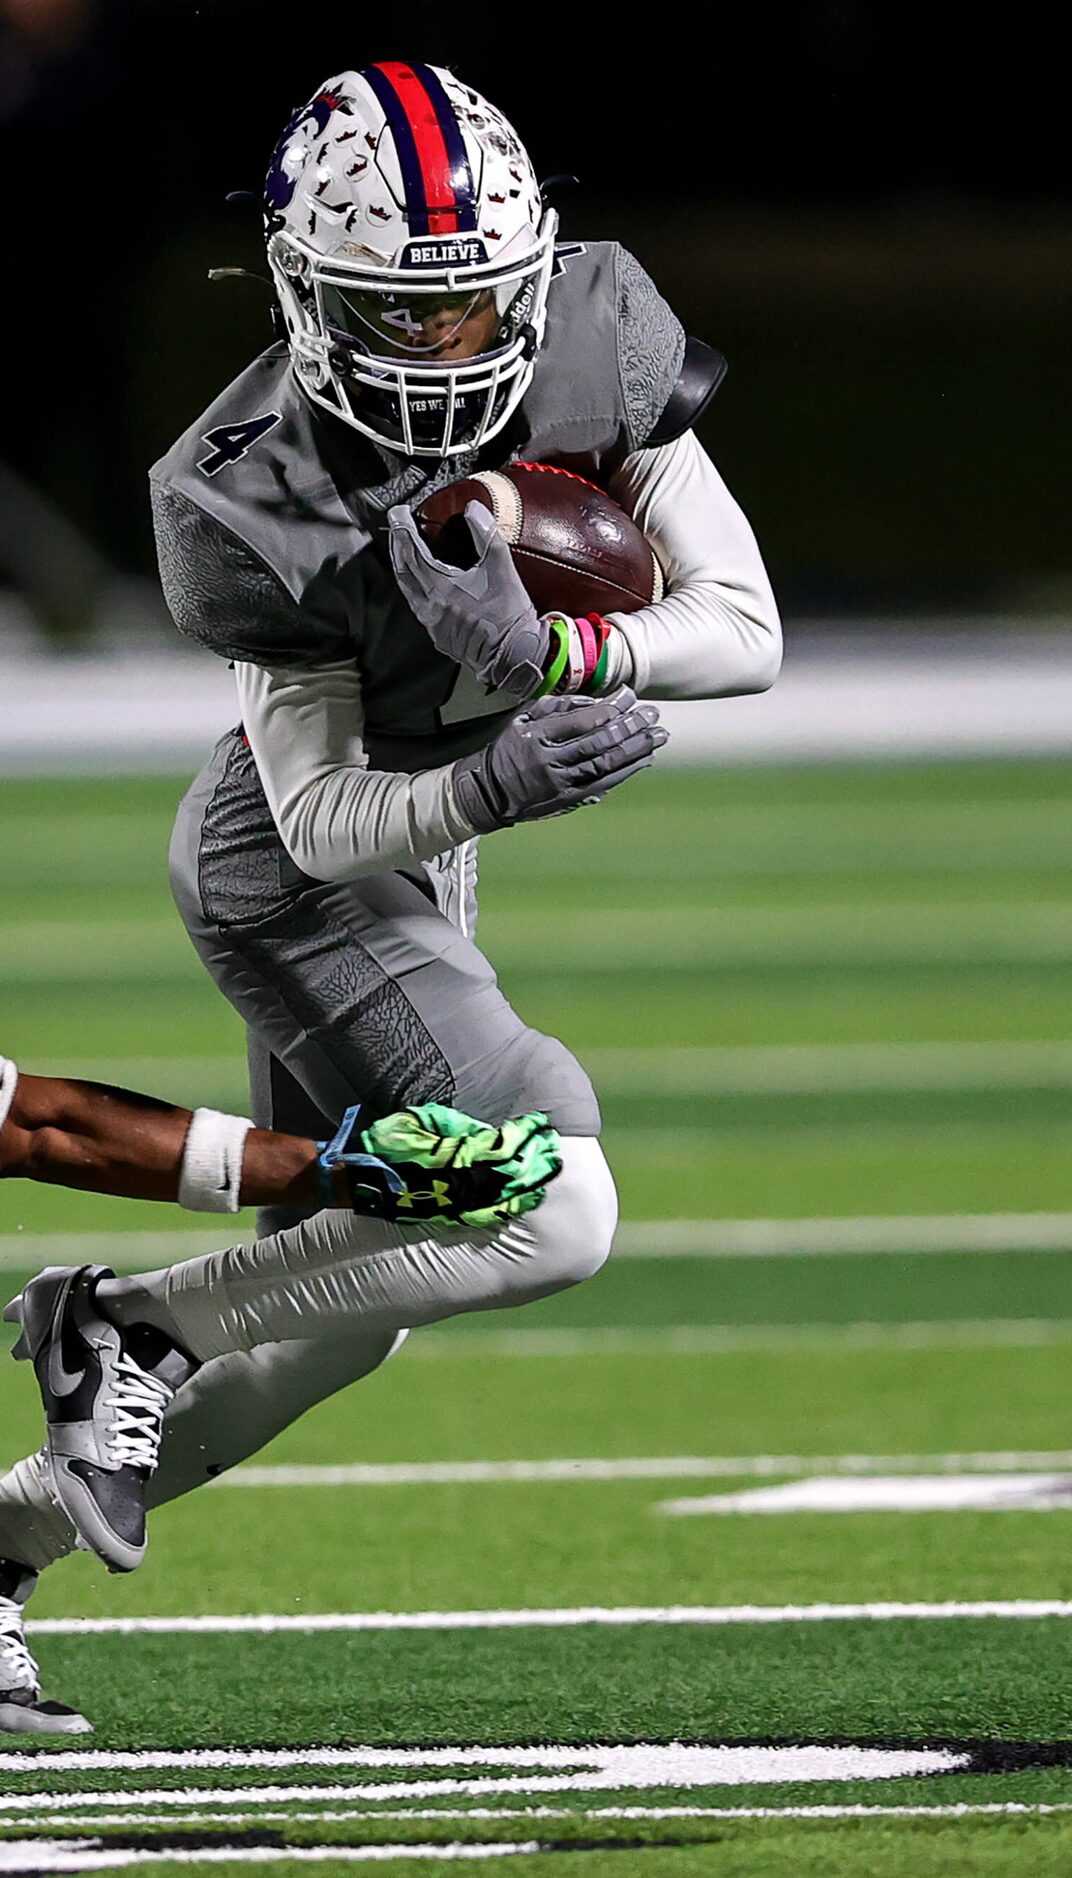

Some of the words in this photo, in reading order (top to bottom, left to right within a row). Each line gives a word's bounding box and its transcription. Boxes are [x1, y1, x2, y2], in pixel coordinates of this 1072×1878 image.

[410, 243, 480, 263] BELIEVE
[499, 282, 535, 339] Rddell
[409, 401, 427, 412] YES
[428, 399, 445, 411] WE
[196, 410, 284, 477] 4
